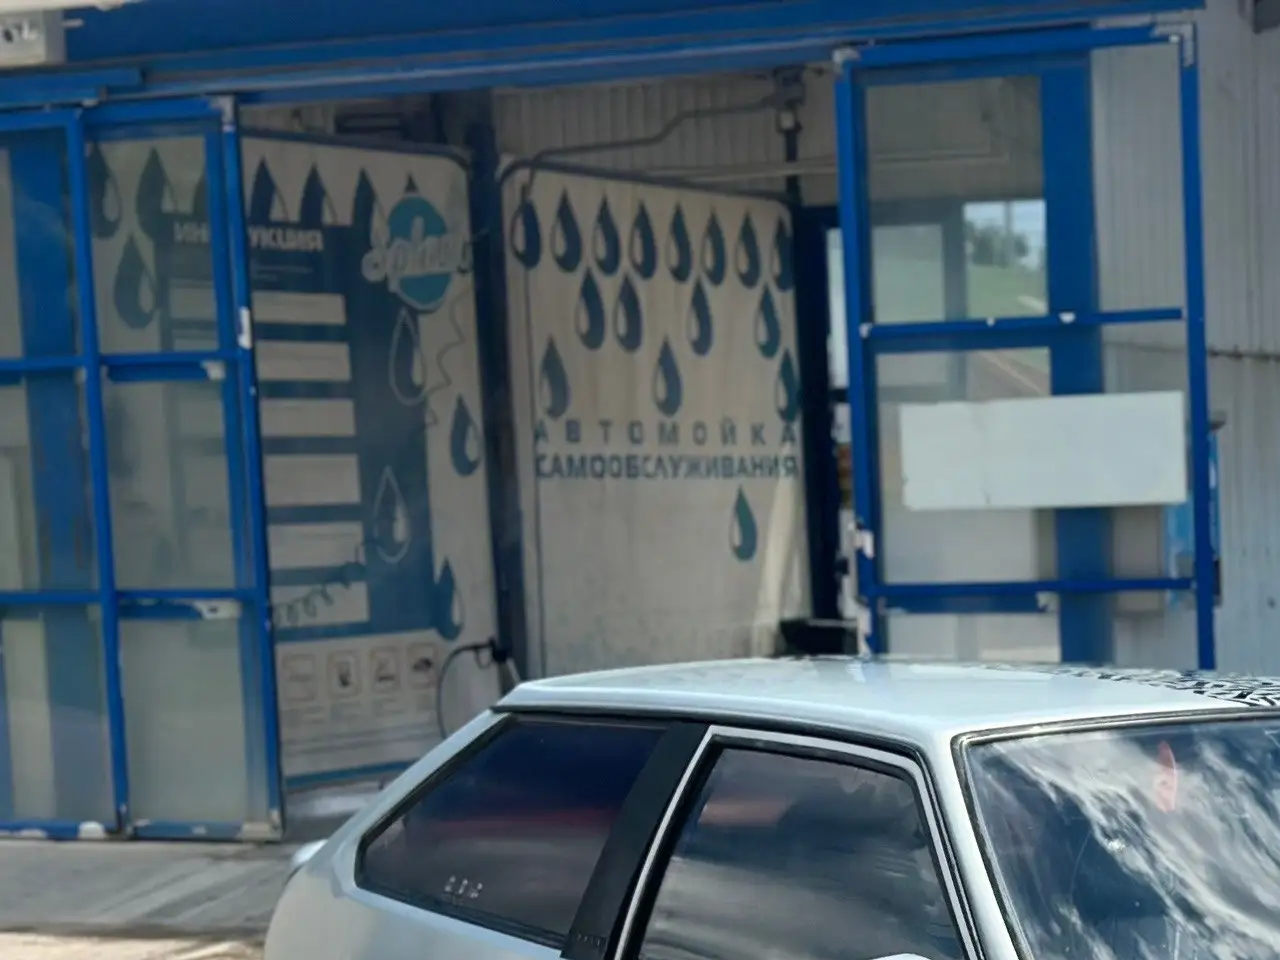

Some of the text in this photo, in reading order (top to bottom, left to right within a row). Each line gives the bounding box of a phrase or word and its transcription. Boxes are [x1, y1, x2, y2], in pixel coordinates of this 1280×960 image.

[172, 221, 325, 252] ИНУКЦИЯ
[534, 416, 797, 444] АВТОМОЙКА
[535, 454, 798, 479] САМООБСЛУЖИВАНИЯ
